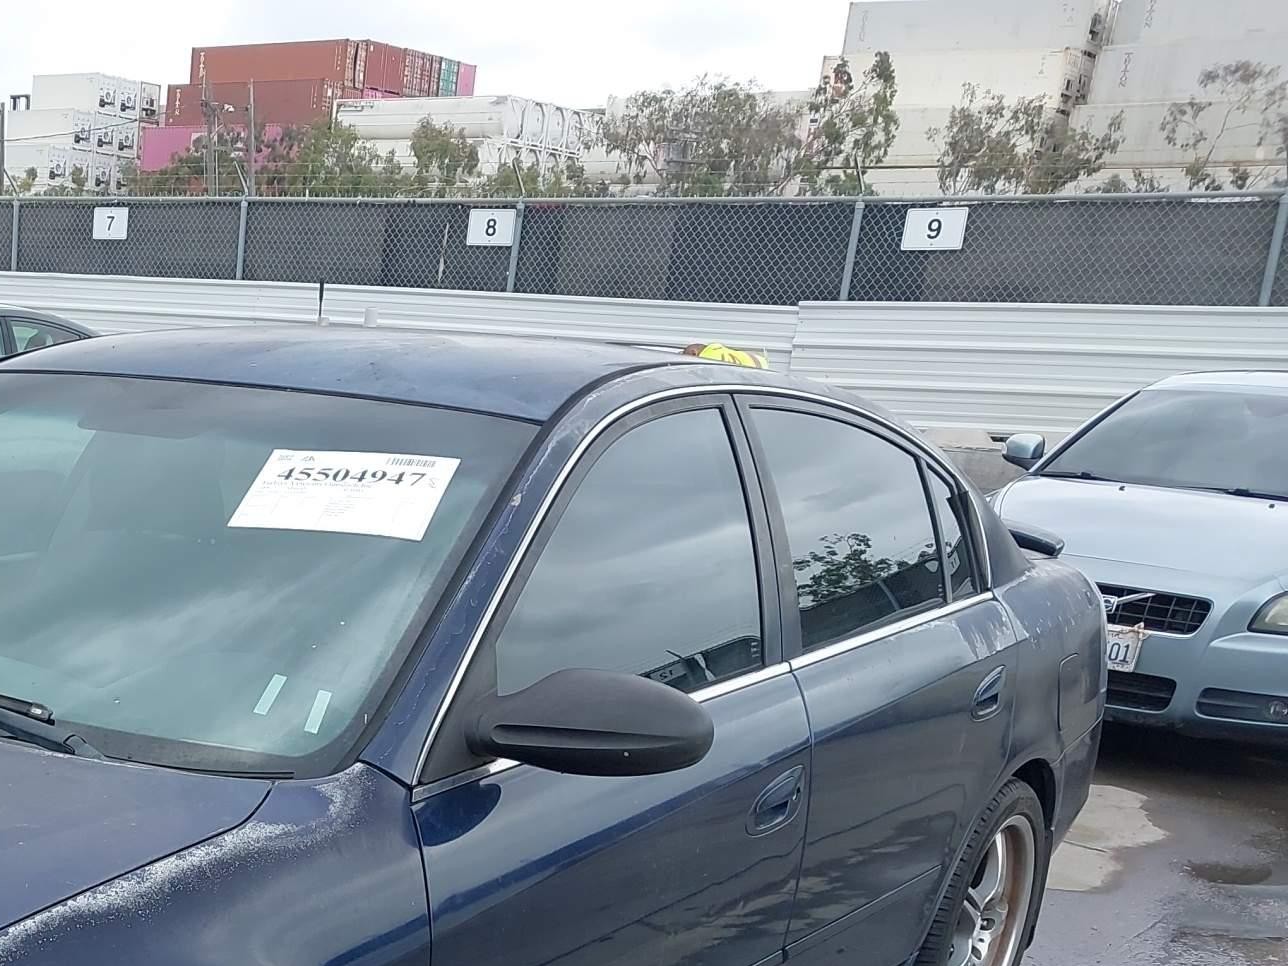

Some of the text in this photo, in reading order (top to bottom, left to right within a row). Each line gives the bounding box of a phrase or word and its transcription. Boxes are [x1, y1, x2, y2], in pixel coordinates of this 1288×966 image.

[107, 215, 115, 231] 7
[485, 218, 497, 237] 8
[926, 218, 943, 240] 9
[277, 466, 427, 487] 45504947
[1107, 641, 1131, 664] 01
